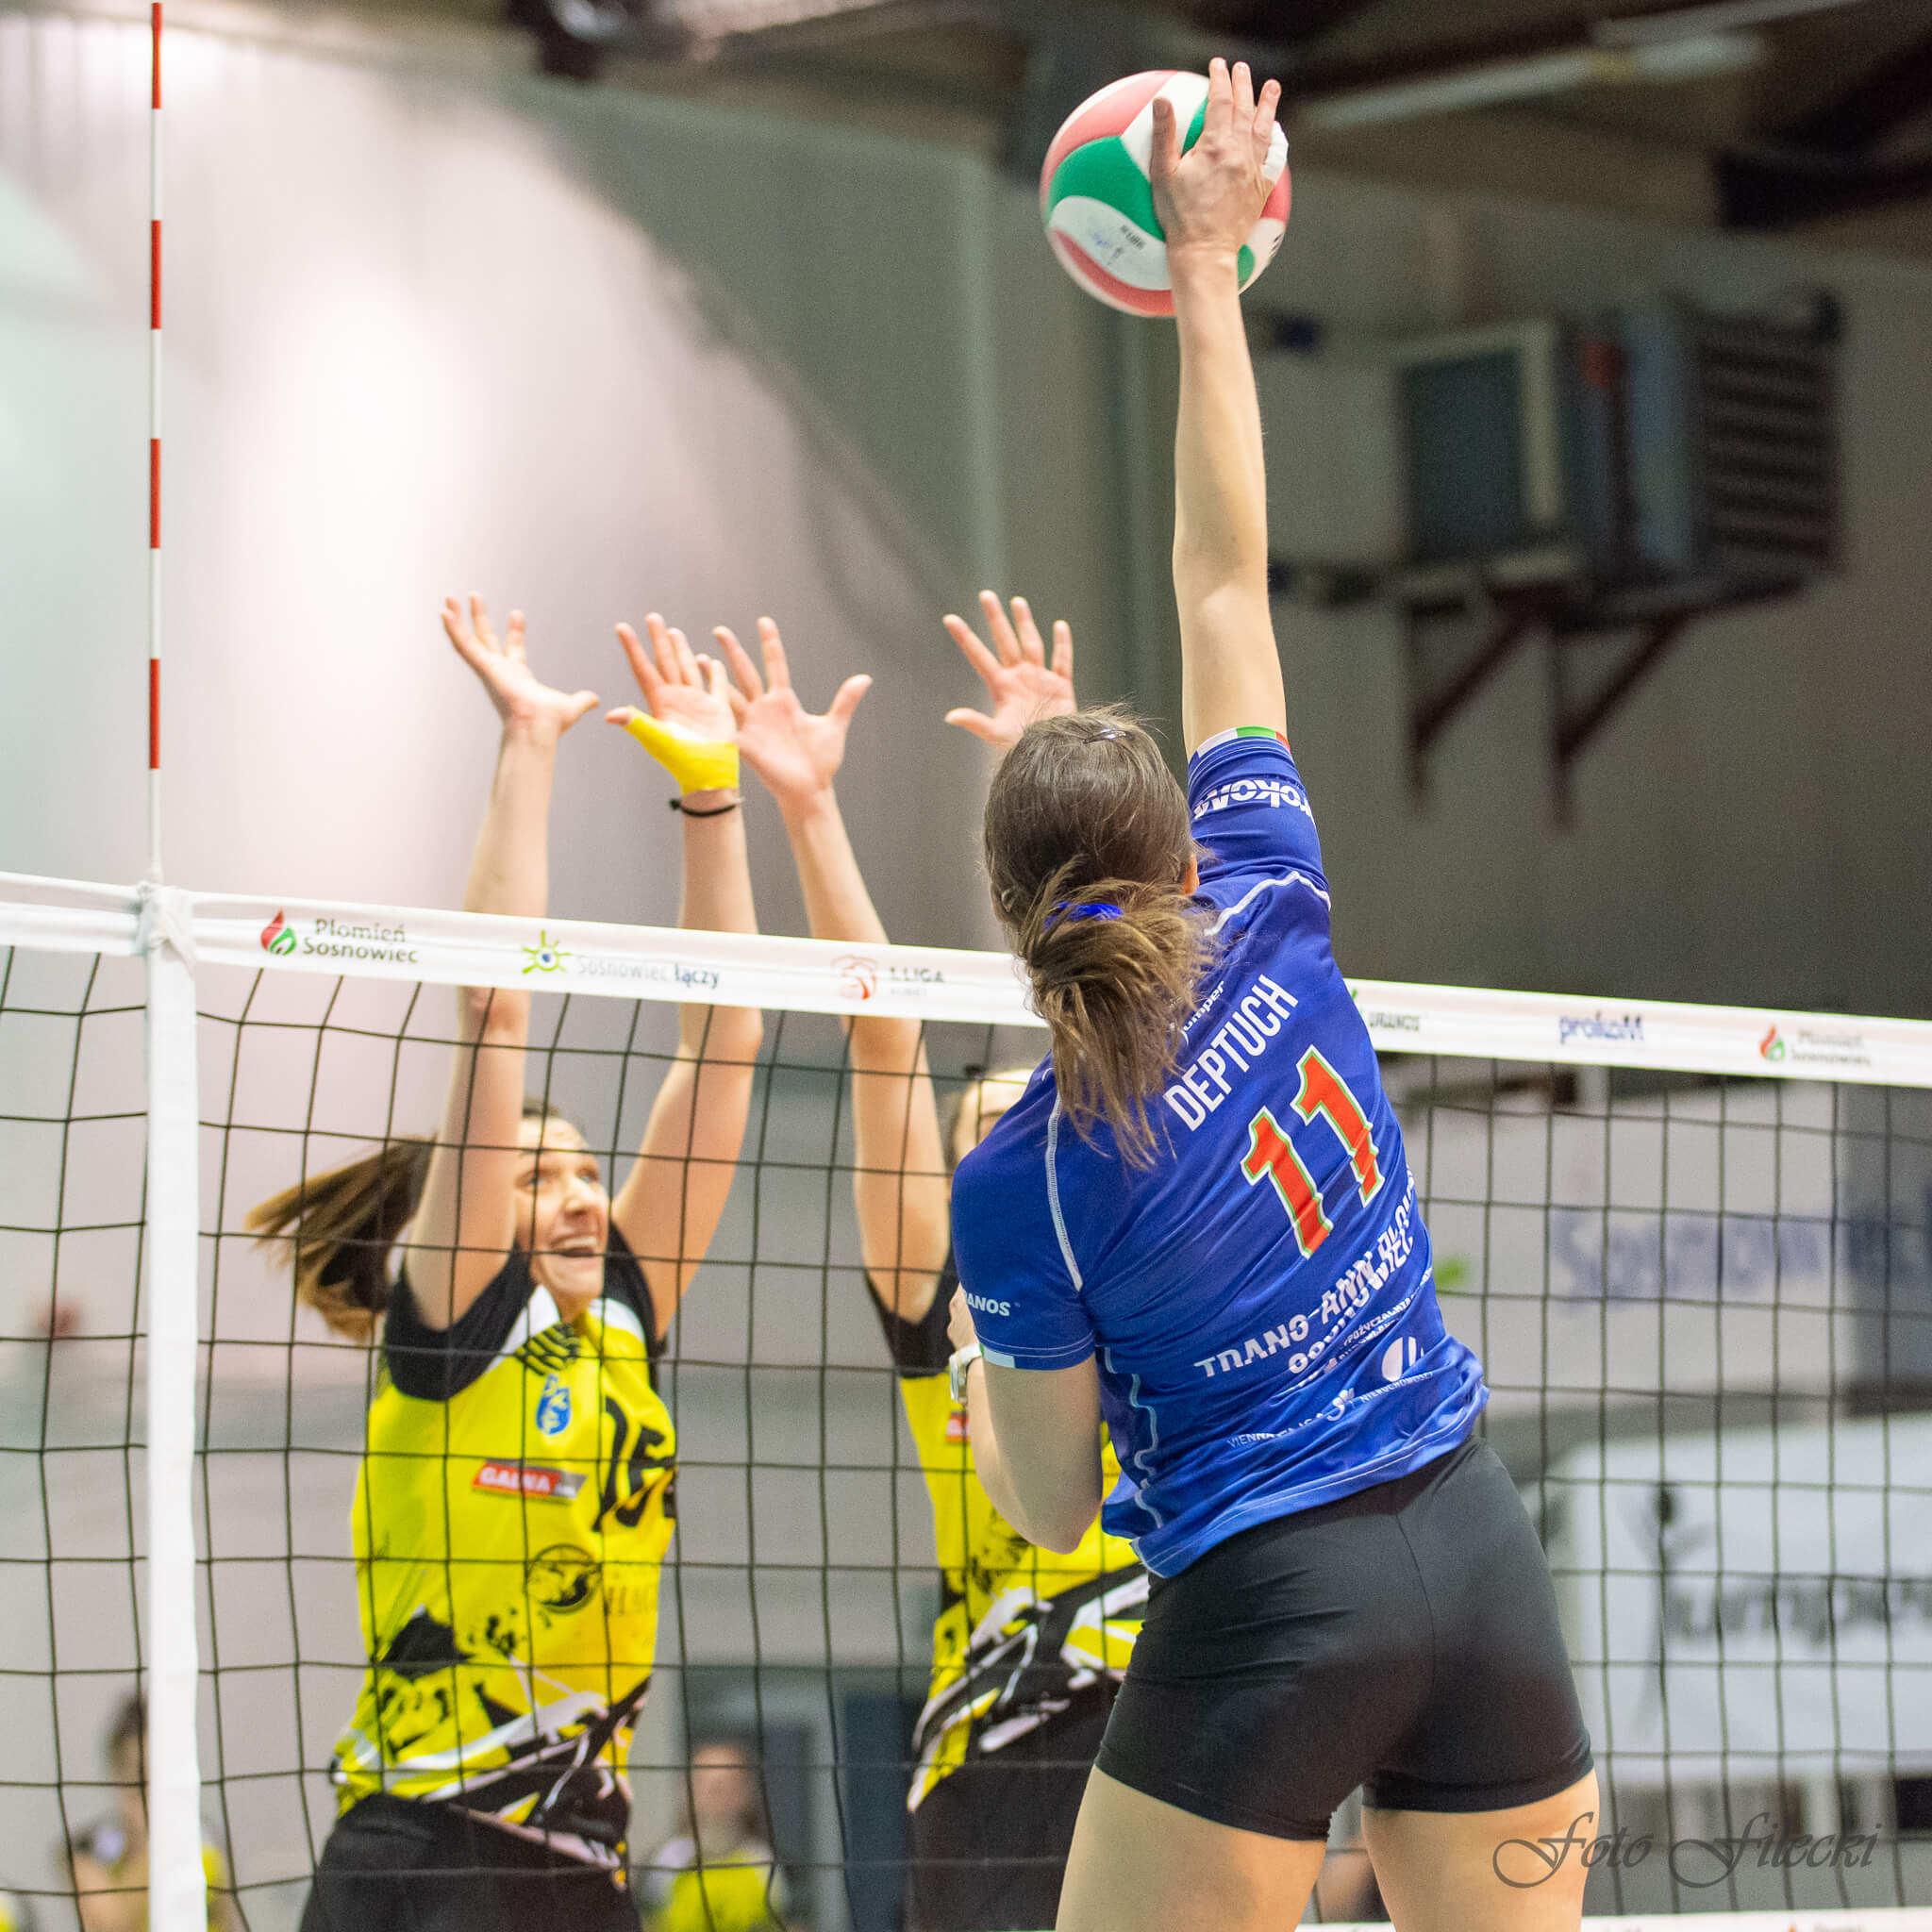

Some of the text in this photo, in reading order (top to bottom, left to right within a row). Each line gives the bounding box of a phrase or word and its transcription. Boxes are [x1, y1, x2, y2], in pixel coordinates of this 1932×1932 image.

[303, 937, 419, 963] Sosnowiec
[575, 955, 668, 981] Sosnowiec
[1162, 974, 1299, 1131] DEPTUCH
[1241, 1044, 1384, 1259] 11
[963, 1290, 1011, 1317] ANOS
